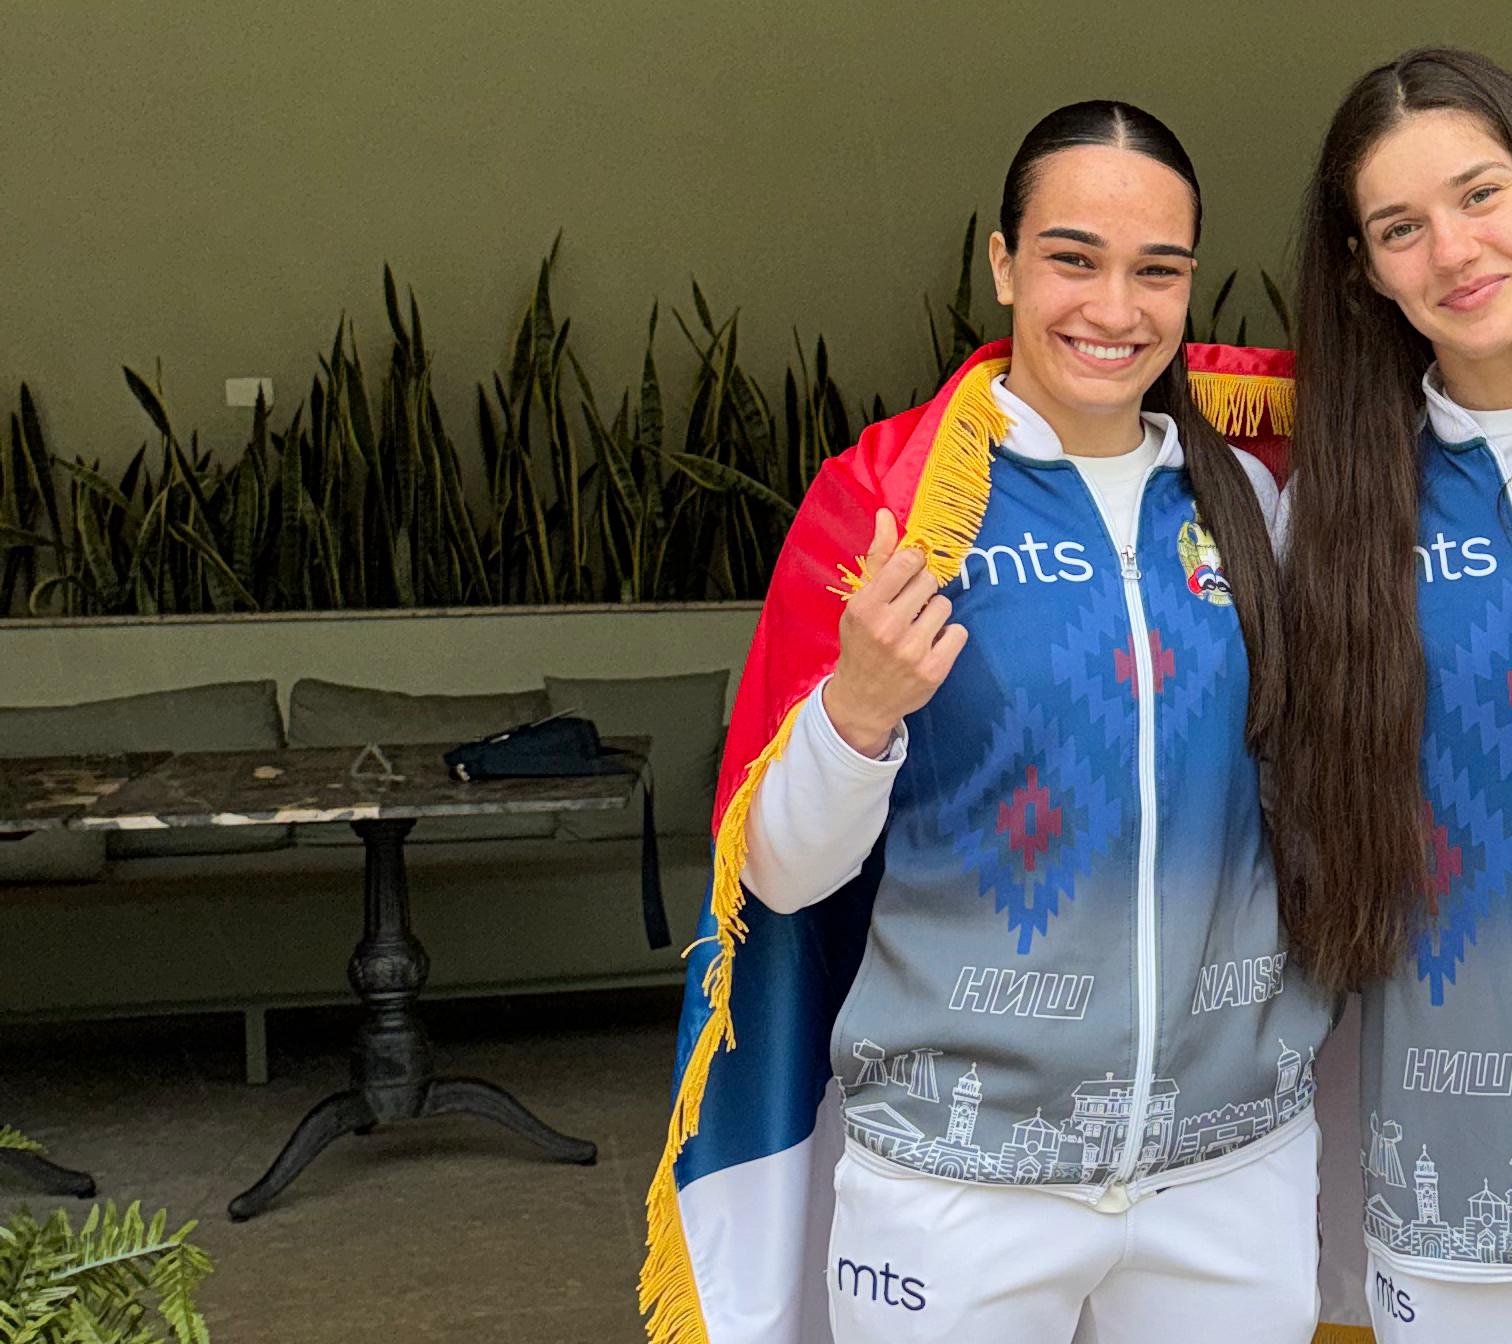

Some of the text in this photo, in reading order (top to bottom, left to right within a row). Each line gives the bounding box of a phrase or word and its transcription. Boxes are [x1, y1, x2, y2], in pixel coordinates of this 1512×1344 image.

[960, 532, 1094, 590] mts
[949, 966, 1095, 1020] НИШ
[838, 1257, 926, 1311] mts
[1376, 1270, 1415, 1323] mts
